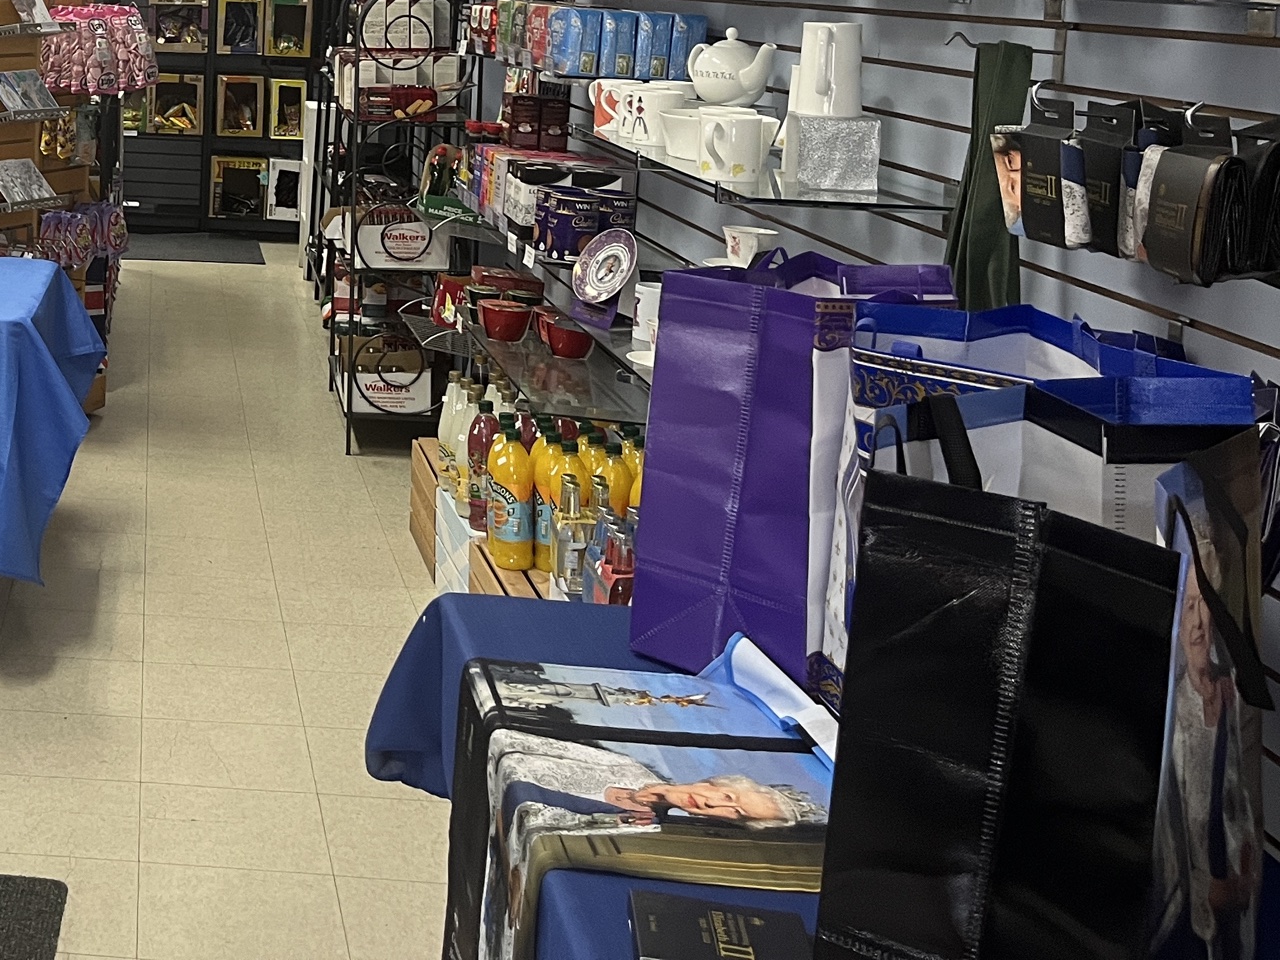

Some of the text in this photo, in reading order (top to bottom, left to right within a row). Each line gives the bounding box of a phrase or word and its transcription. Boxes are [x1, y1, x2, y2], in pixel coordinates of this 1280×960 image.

[575, 202, 591, 210] WIN
[613, 200, 628, 208] WIN
[443, 206, 463, 214] PRICE
[383, 232, 426, 242] Walkers
[364, 383, 410, 393] Walkers
